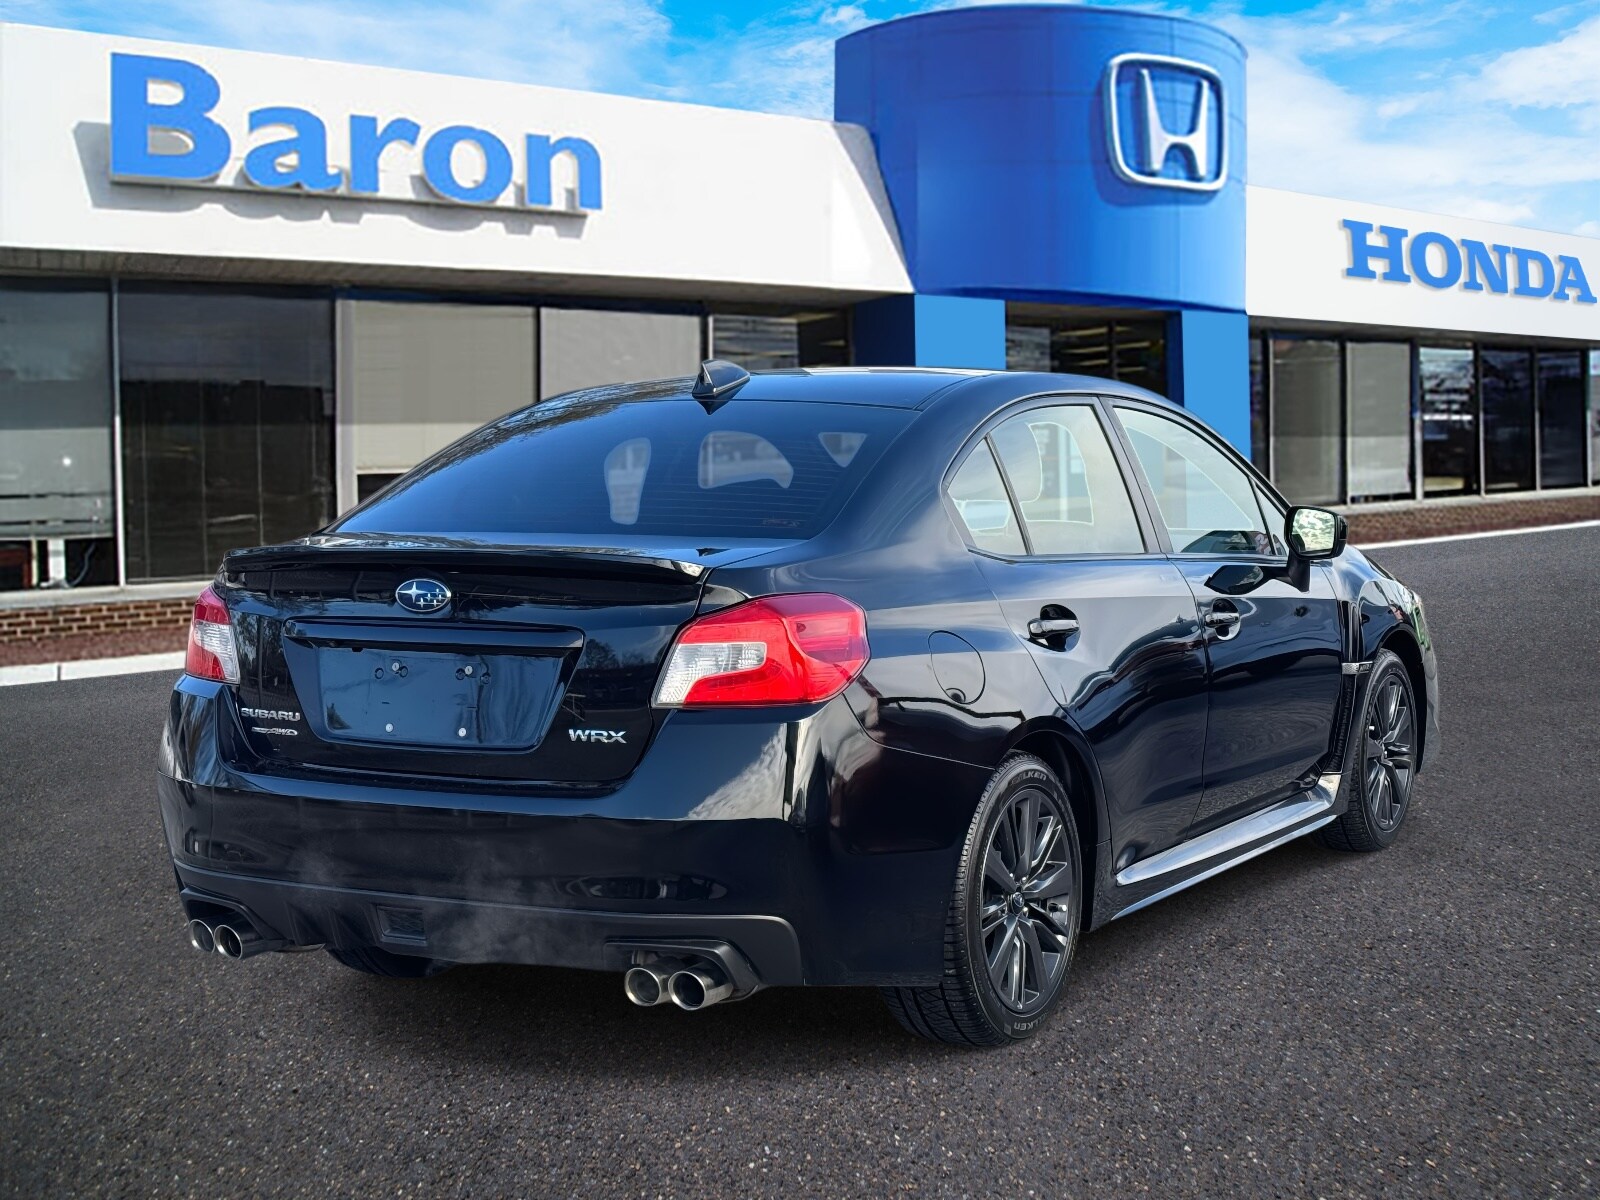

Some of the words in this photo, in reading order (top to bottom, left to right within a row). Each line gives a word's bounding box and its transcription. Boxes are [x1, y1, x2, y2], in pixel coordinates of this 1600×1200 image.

[110, 52, 603, 210] Baron
[1342, 218, 1598, 304] HONDA
[240, 707, 301, 721] SUBARU
[568, 728, 627, 744] WRX
